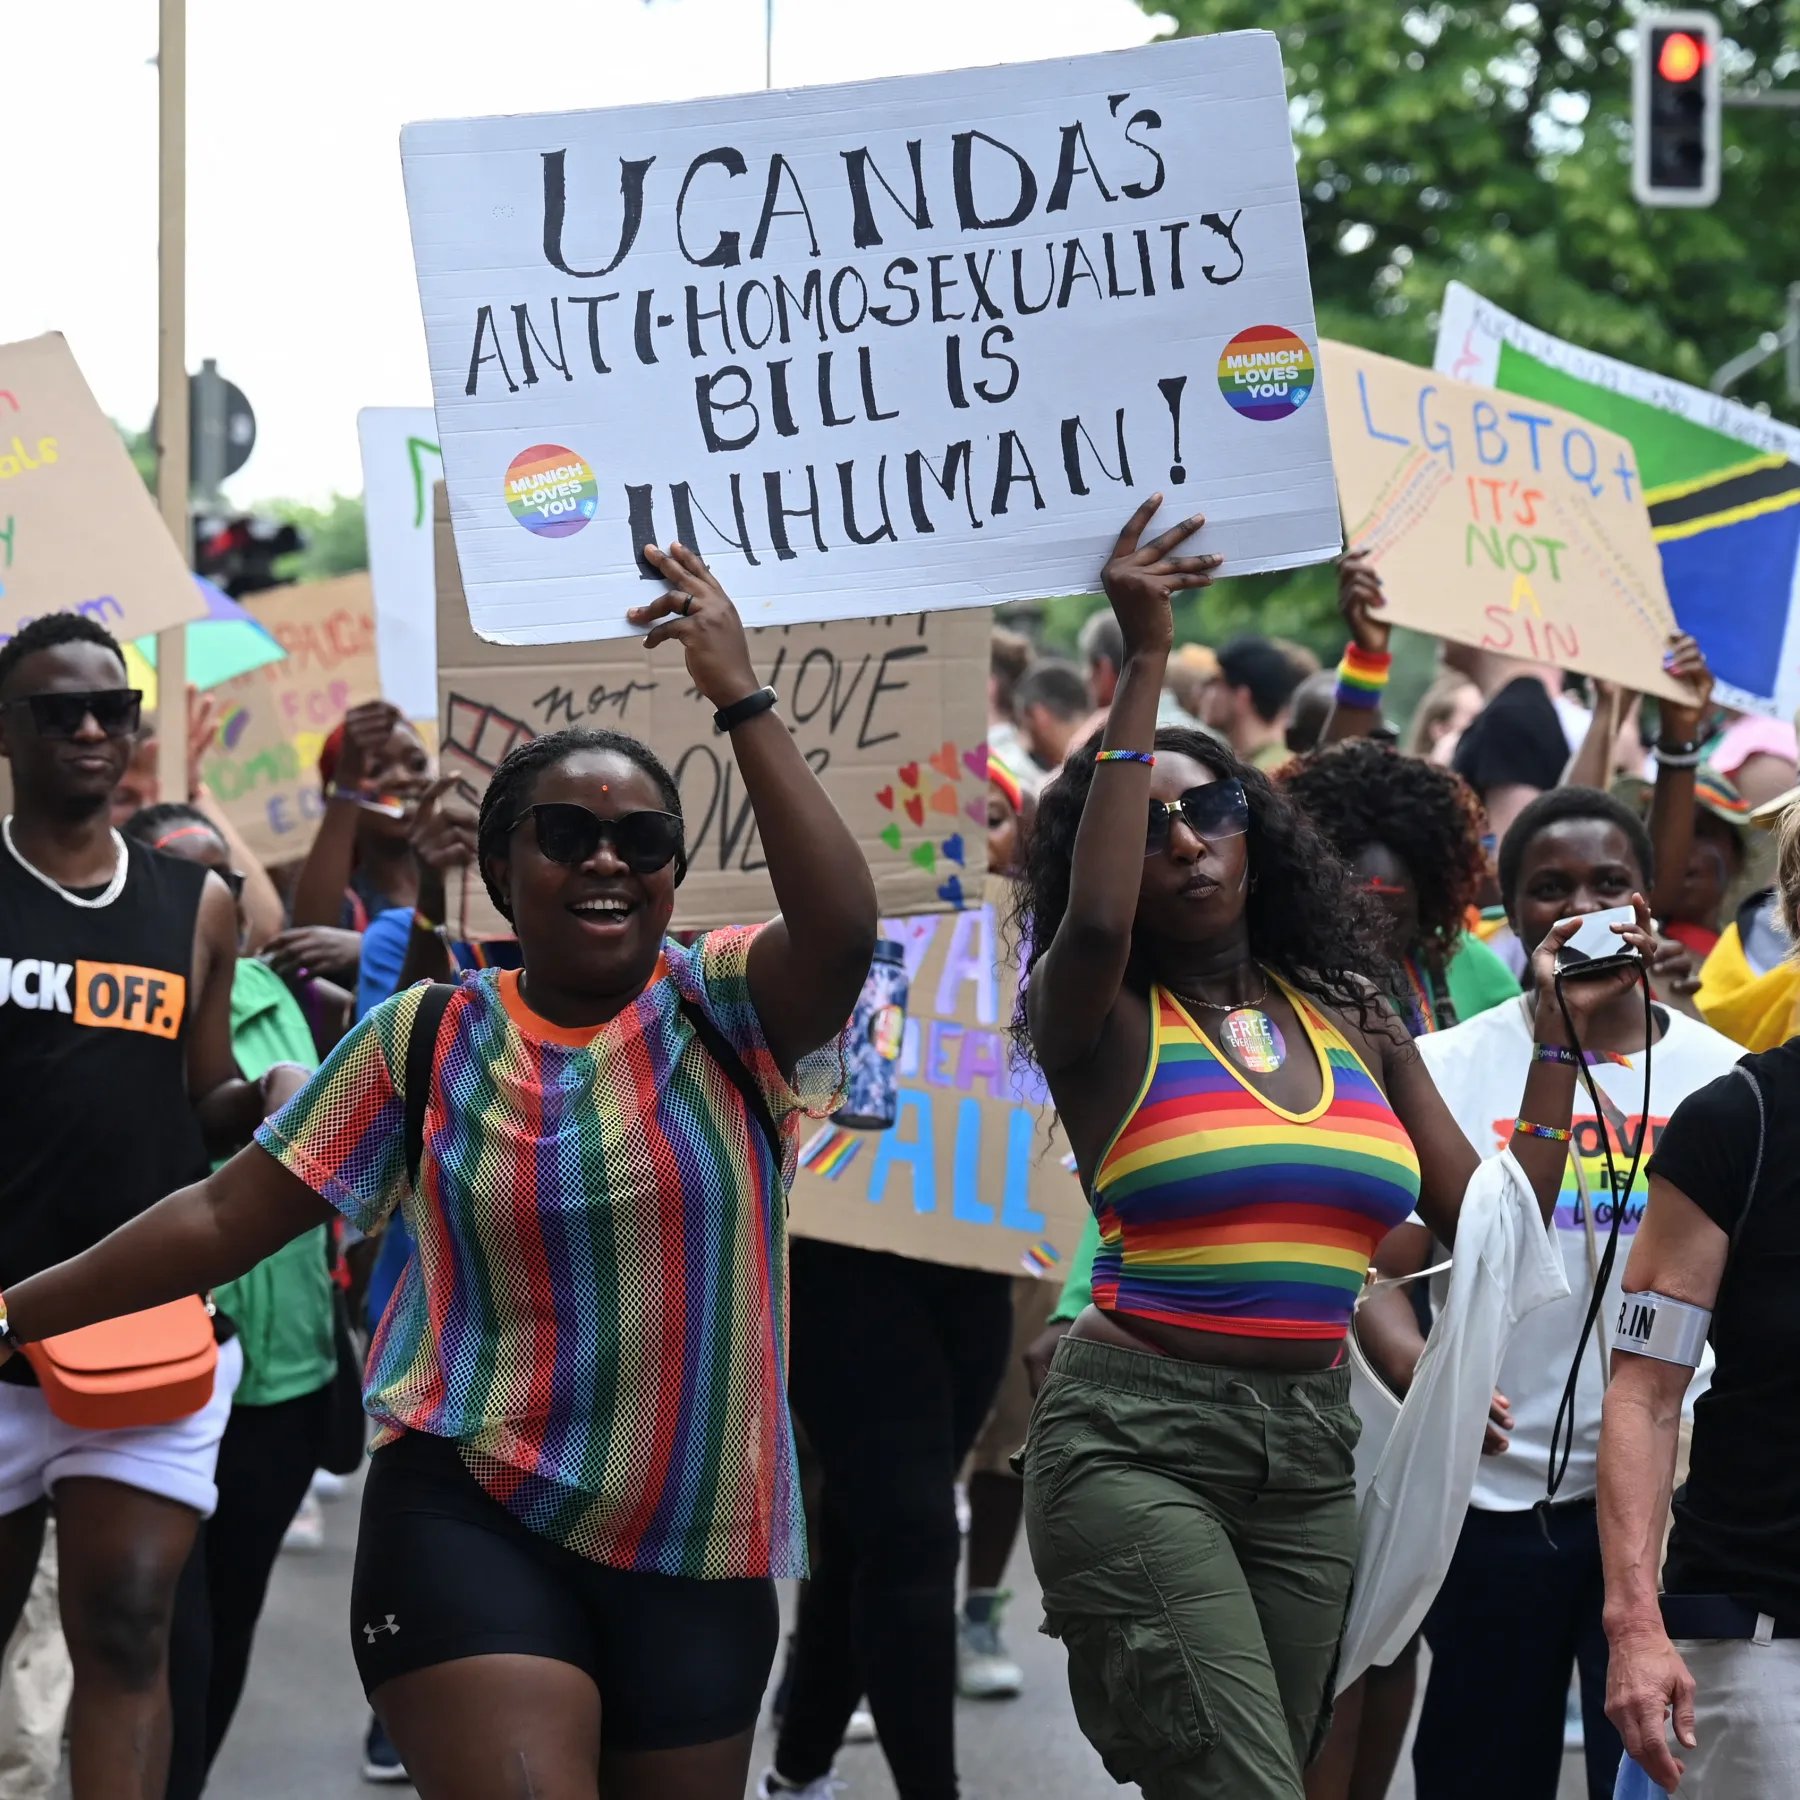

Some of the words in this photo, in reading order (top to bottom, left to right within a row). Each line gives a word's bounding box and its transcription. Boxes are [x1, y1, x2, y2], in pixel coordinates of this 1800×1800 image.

[541, 93, 1165, 278] UGANDA'S
[466, 209, 1243, 395] ANTI-HOMOSEXUALITY
[1227, 349, 1304, 369] MUNICH
[1234, 365, 1299, 384] LOVES
[695, 347, 899, 452] BILL
[947, 325, 1019, 408] IS
[1246, 382, 1288, 398] YOU
[1357, 370, 1636, 503] LGBTQ+
[510, 463, 584, 493] MUNICH
[521, 480, 583, 507] LOVES
[1467, 475, 1545, 527] IT'S
[537, 497, 577, 518] YOU
[1466, 523, 1567, 582] NOT
[1511, 574, 1542, 617] A
[1481, 605, 1580, 662] SIN
[88, 973, 172, 1029] OFF.
[1228, 1018, 1271, 1038] FREE
[866, 1088, 1046, 1233] ALL
[1601, 1163, 1630, 1190] is
